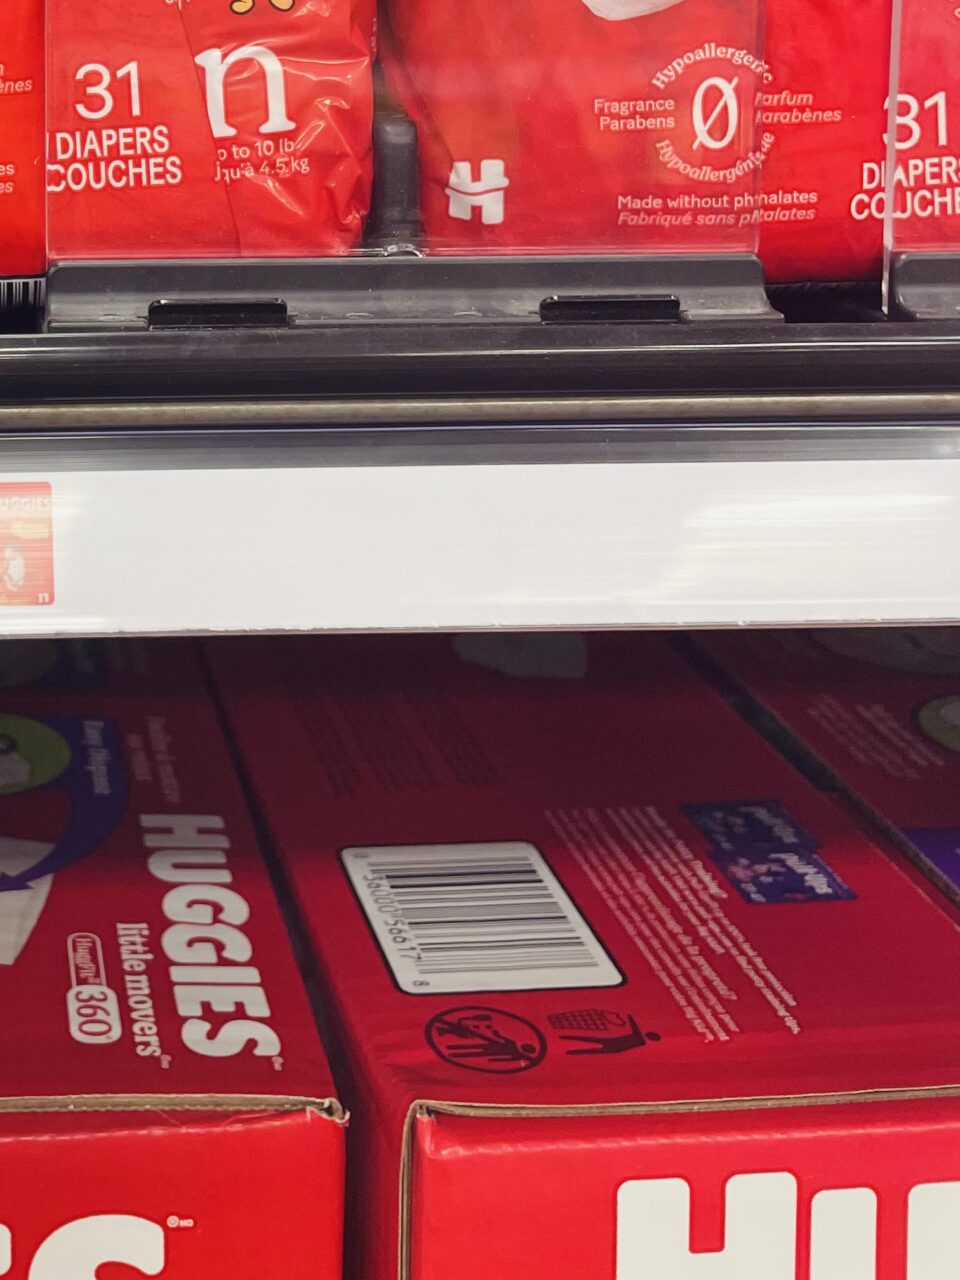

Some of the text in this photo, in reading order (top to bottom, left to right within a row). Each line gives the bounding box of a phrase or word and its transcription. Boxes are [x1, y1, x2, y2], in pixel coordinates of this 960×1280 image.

[74, 61, 141, 120] 31
[193, 45, 297, 139] n
[594, 98, 676, 117] Fragrance
[599, 116, 676, 131] Parabens
[881, 91, 949, 151] 31
[56, 124, 171, 161] DIAPERS
[231, 144, 251, 158] to
[254, 139, 275, 156] 10
[46, 155, 184, 193] COUCHES
[290, 156, 312, 175] kg
[617, 193, 730, 210] Made without
[617, 210, 736, 227] Fabriqué sans
[140, 814, 282, 1058] HUGGIES
[117, 922, 160, 1057] little movers
[74, 985, 113, 1039] 360
